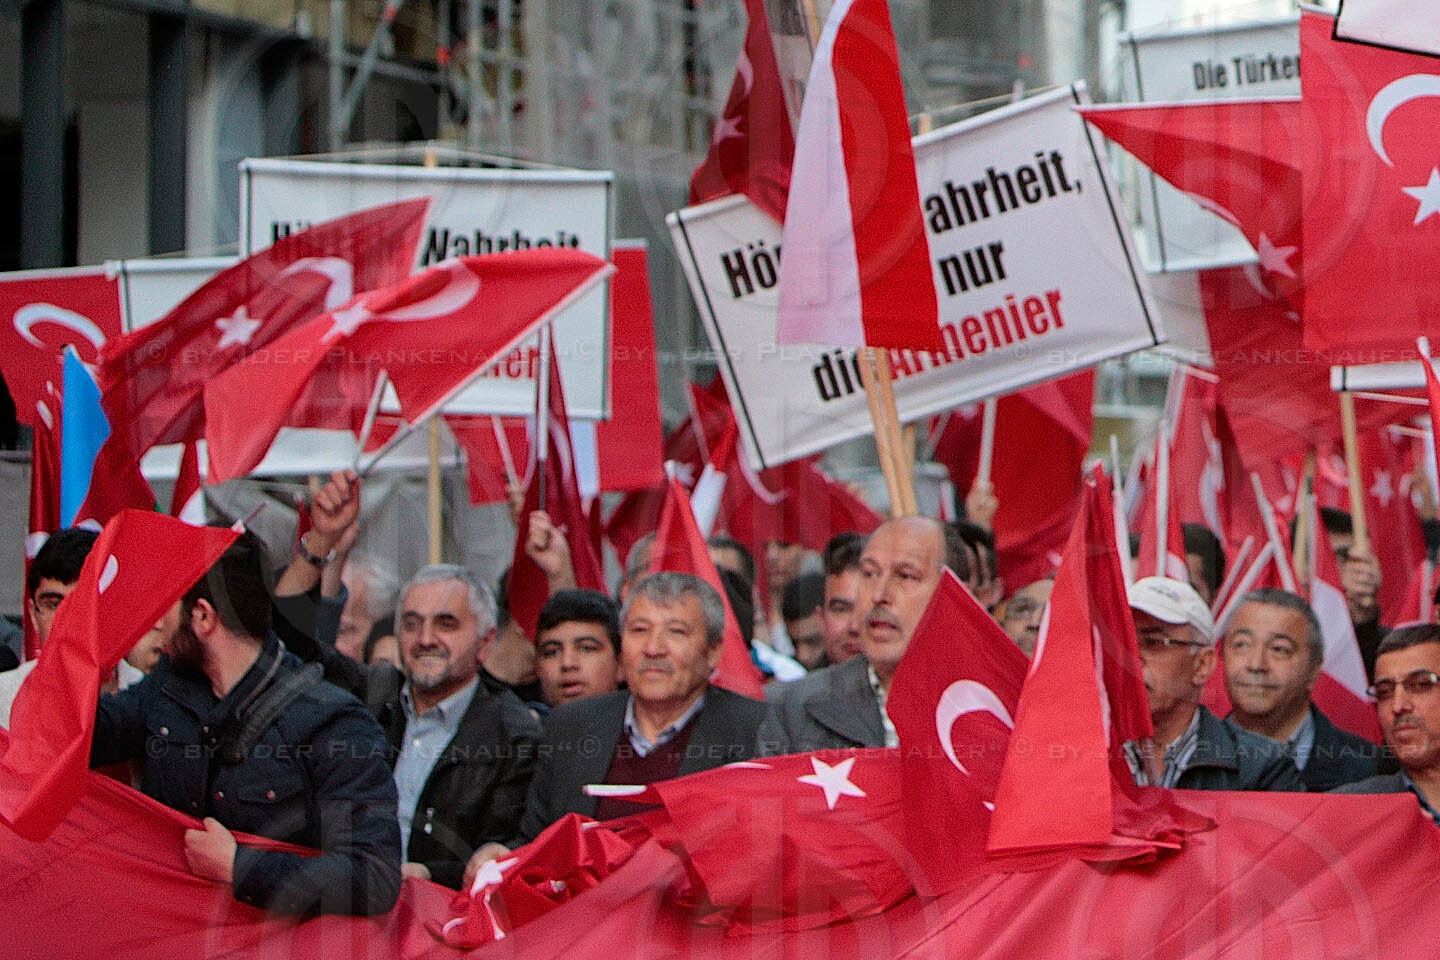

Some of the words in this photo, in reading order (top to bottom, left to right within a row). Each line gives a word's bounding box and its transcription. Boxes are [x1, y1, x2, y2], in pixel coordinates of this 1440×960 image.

[1192, 59, 1227, 90] Die
[721, 241, 782, 298] Hö
[939, 241, 1006, 296] nur
